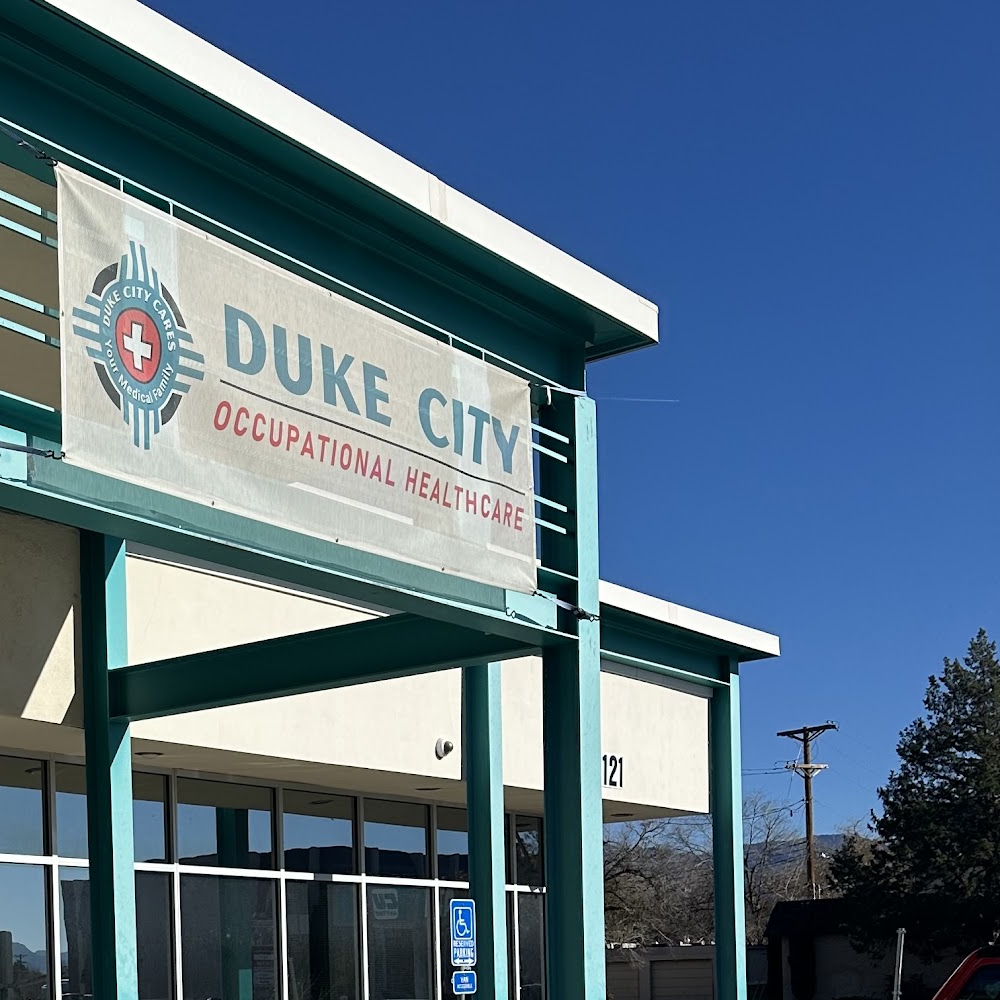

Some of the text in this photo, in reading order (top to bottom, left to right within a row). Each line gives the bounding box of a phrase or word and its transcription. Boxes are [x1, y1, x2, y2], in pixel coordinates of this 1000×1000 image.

[103, 285, 176, 353] DUKE CITY CARES
[104, 339, 175, 405] Your Medical Family
[223, 303, 520, 474] DUKE CITY
[213, 400, 524, 532] OCCUPATIONAL HEALTHCARE
[602, 754, 623, 788] 121
[454, 948, 474, 958] PARKING
